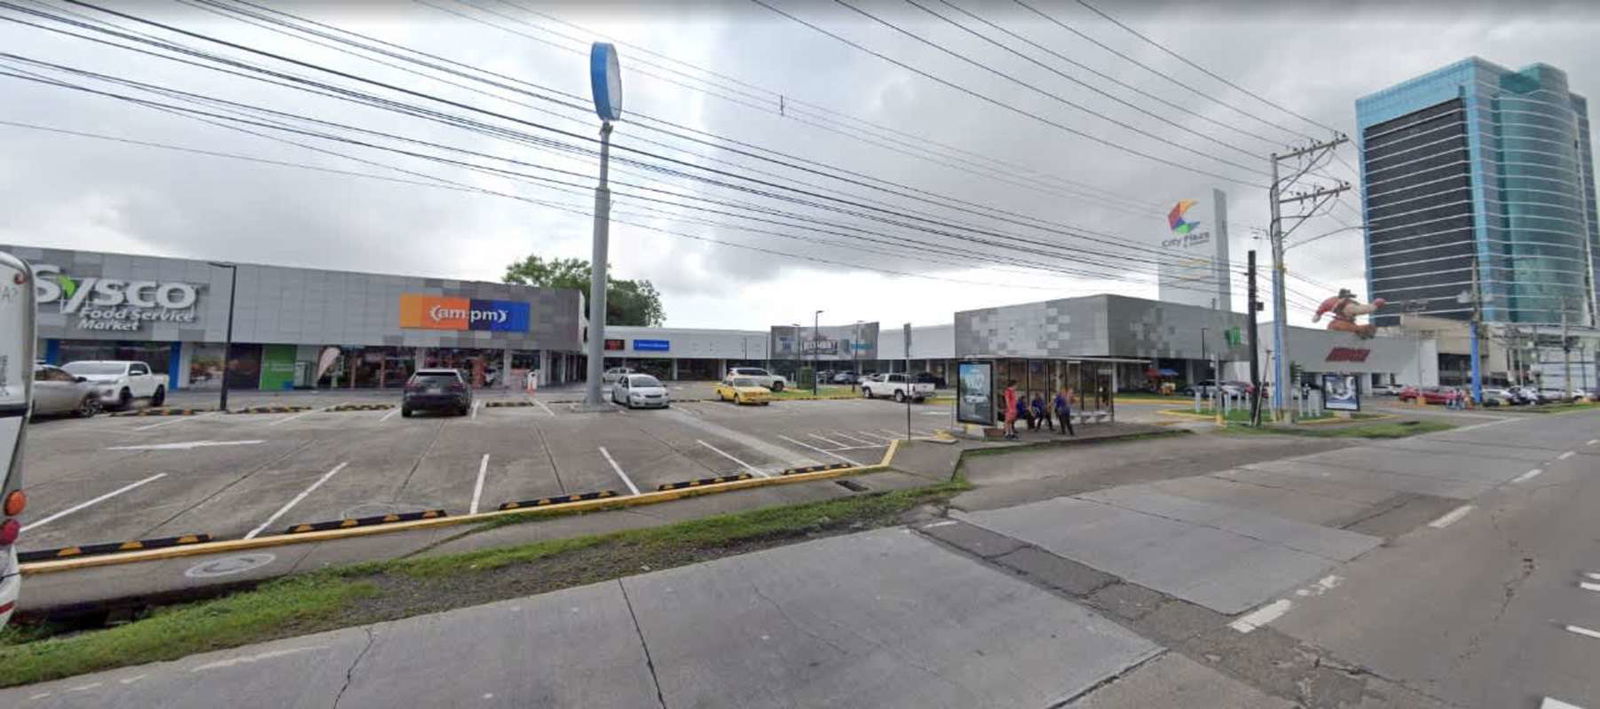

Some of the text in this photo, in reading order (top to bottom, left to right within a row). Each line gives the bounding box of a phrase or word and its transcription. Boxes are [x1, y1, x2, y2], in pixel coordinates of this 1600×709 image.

[1161, 238, 1181, 247] City
[1183, 231, 1209, 243] Plaza
[79, 307, 196, 322] Food Service
[78, 318, 140, 331] Market
